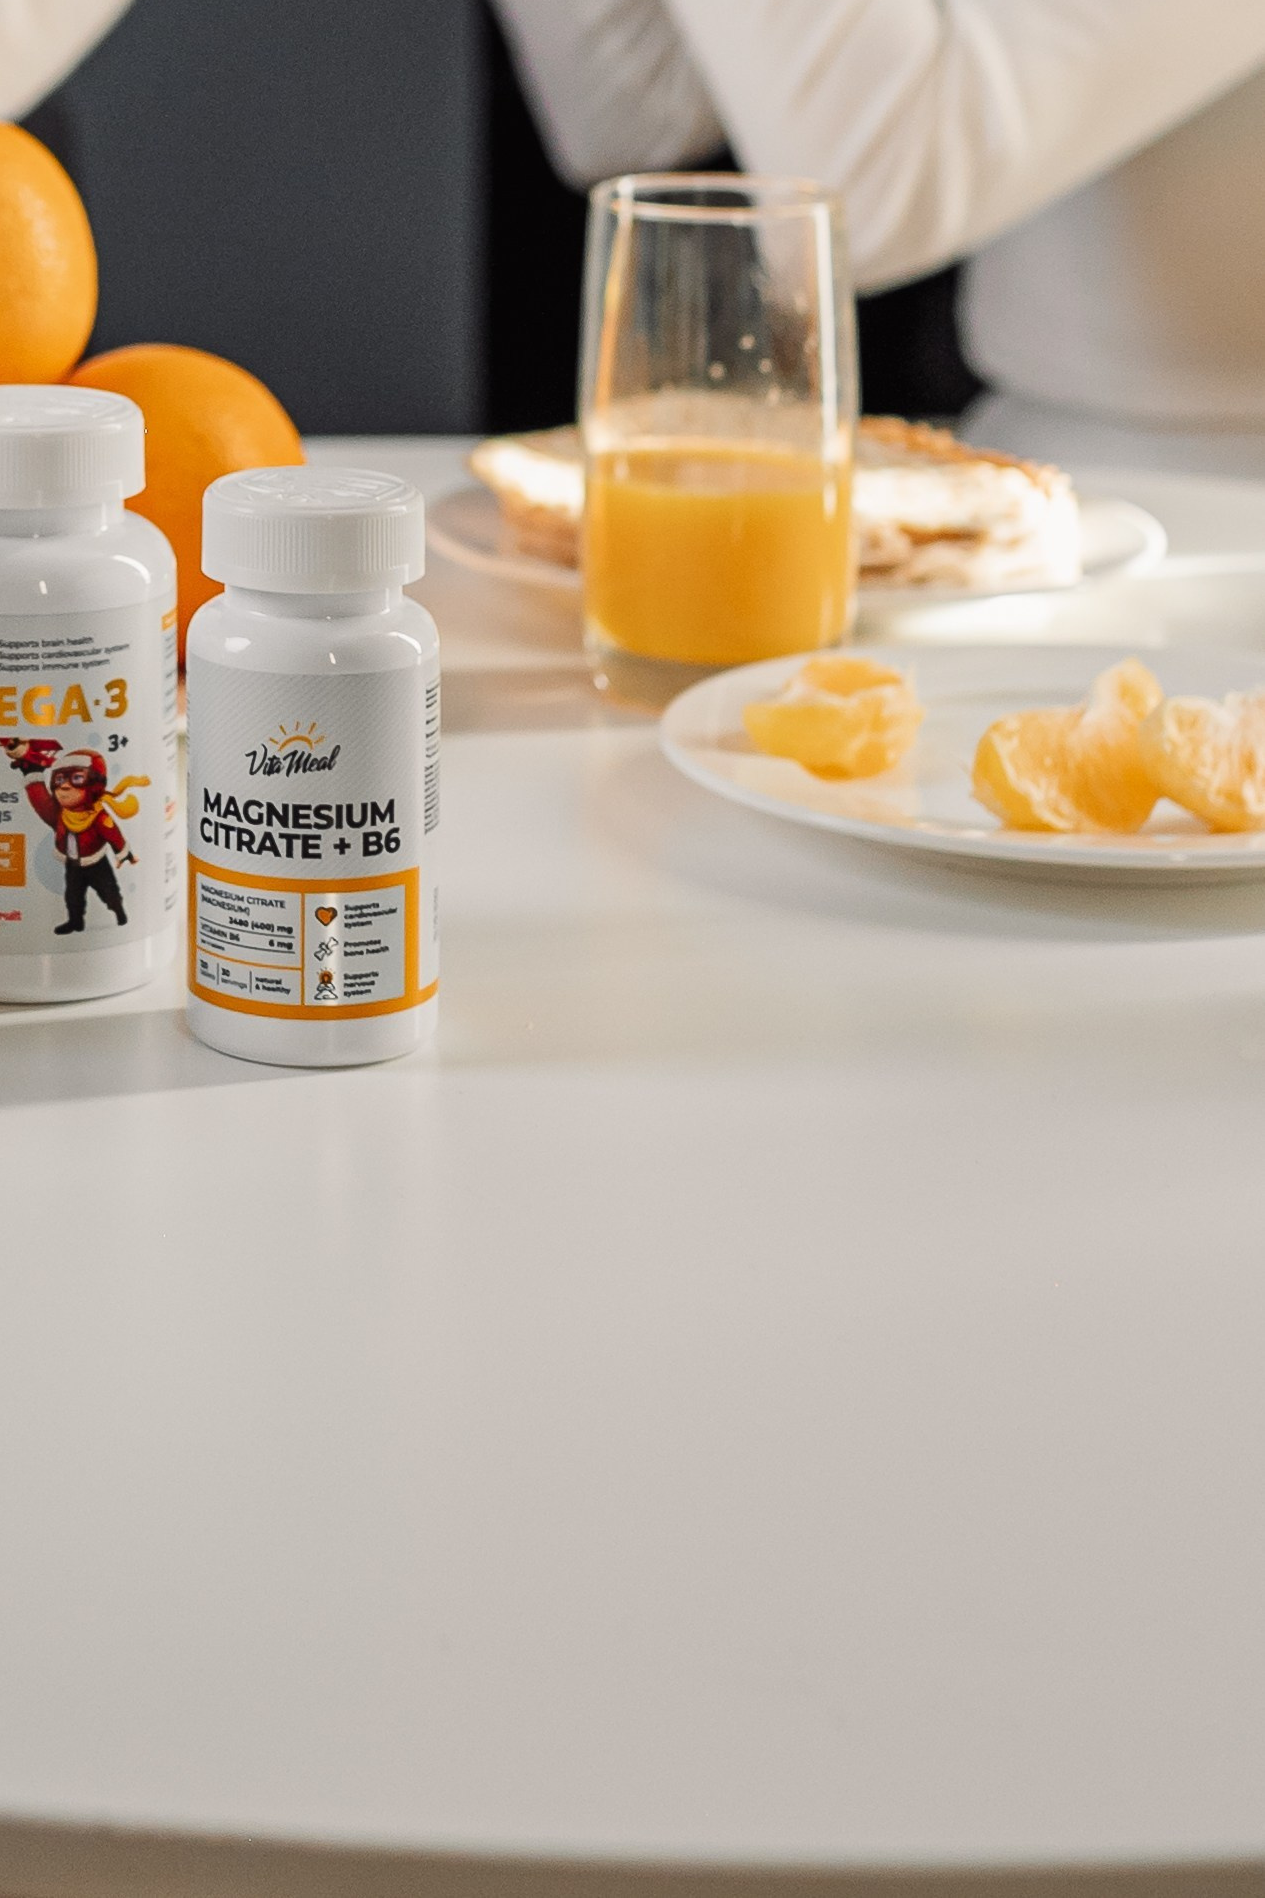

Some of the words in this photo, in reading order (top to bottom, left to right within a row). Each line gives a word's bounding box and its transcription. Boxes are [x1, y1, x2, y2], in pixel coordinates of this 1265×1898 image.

[108, 734, 128, 752] 3+
[245, 743, 283, 776] Vita
[283, 745, 341, 777] Meal
[203, 787, 395, 830] MAGNESIUM
[200, 817, 322, 859] CITRATE
[333, 837, 351, 855] +
[362, 827, 401, 857] B6
[246, 896, 286, 909] CITRATE
